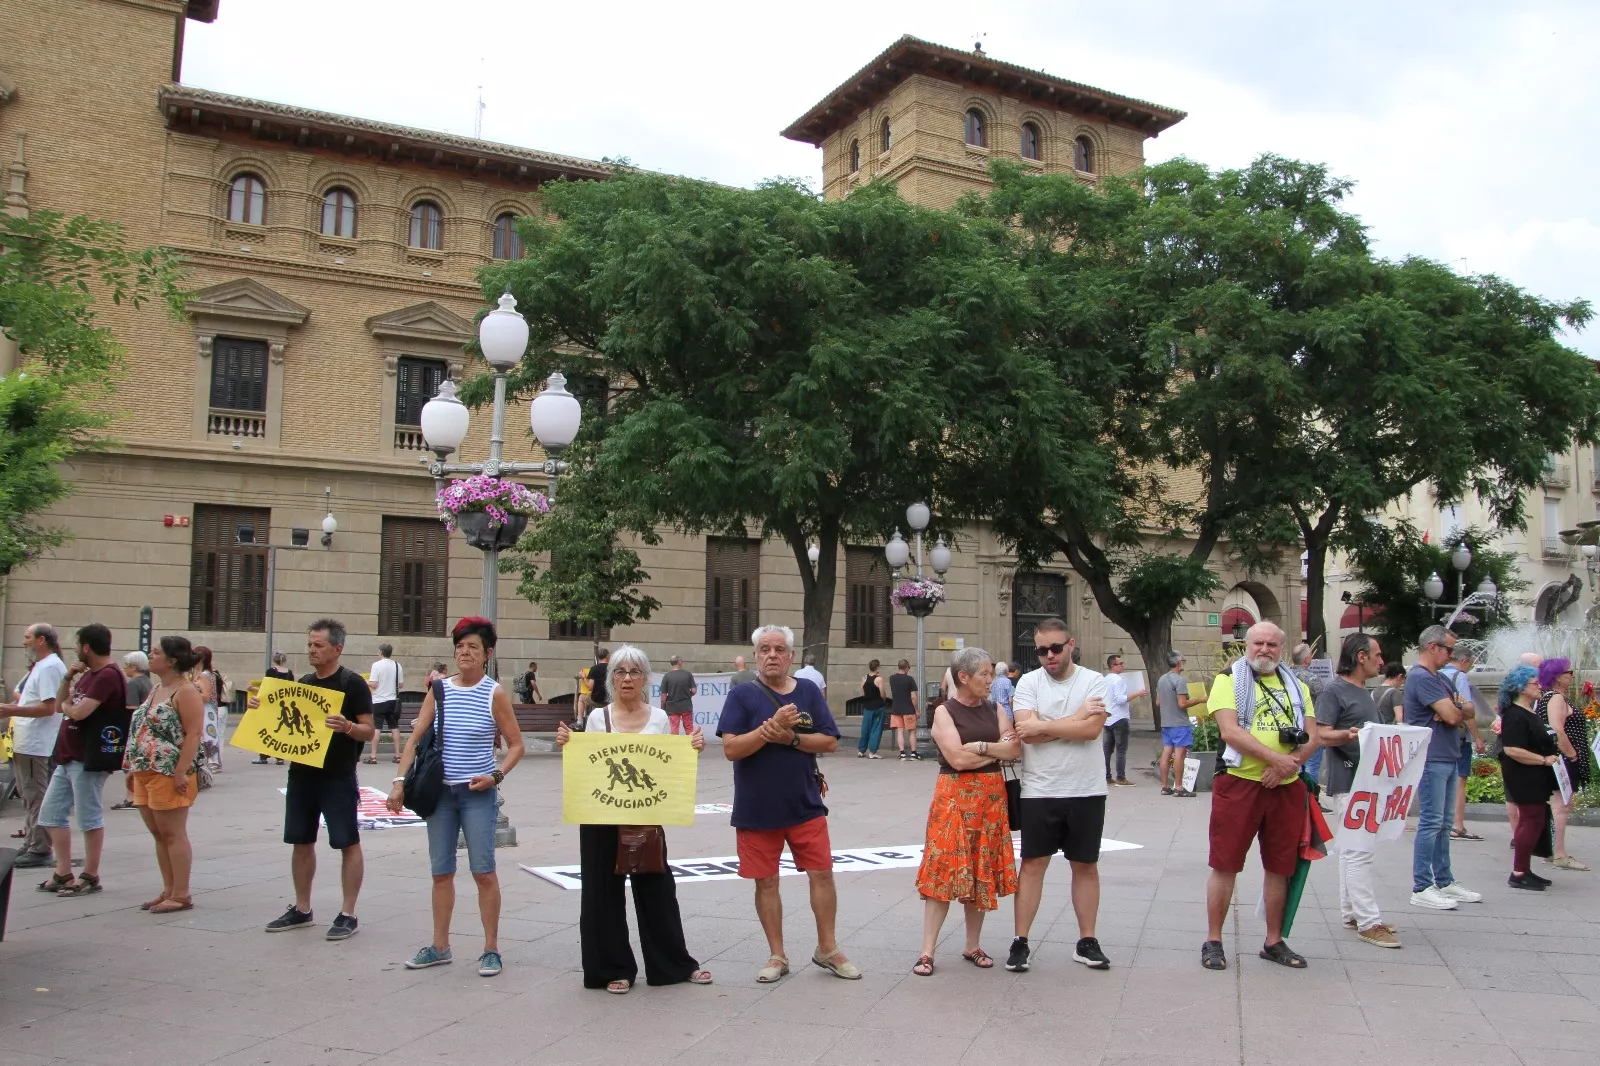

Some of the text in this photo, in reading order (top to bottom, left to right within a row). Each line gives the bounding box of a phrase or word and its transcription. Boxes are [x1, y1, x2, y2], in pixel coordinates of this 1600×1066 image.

[267, 686, 331, 714] BIENVENIDXS
[258, 728, 321, 756] REFUGIADXS
[588, 744, 672, 764] BIENVENIDXS
[1373, 735, 1404, 778] NO
[591, 788, 668, 809] REFUGIADXS
